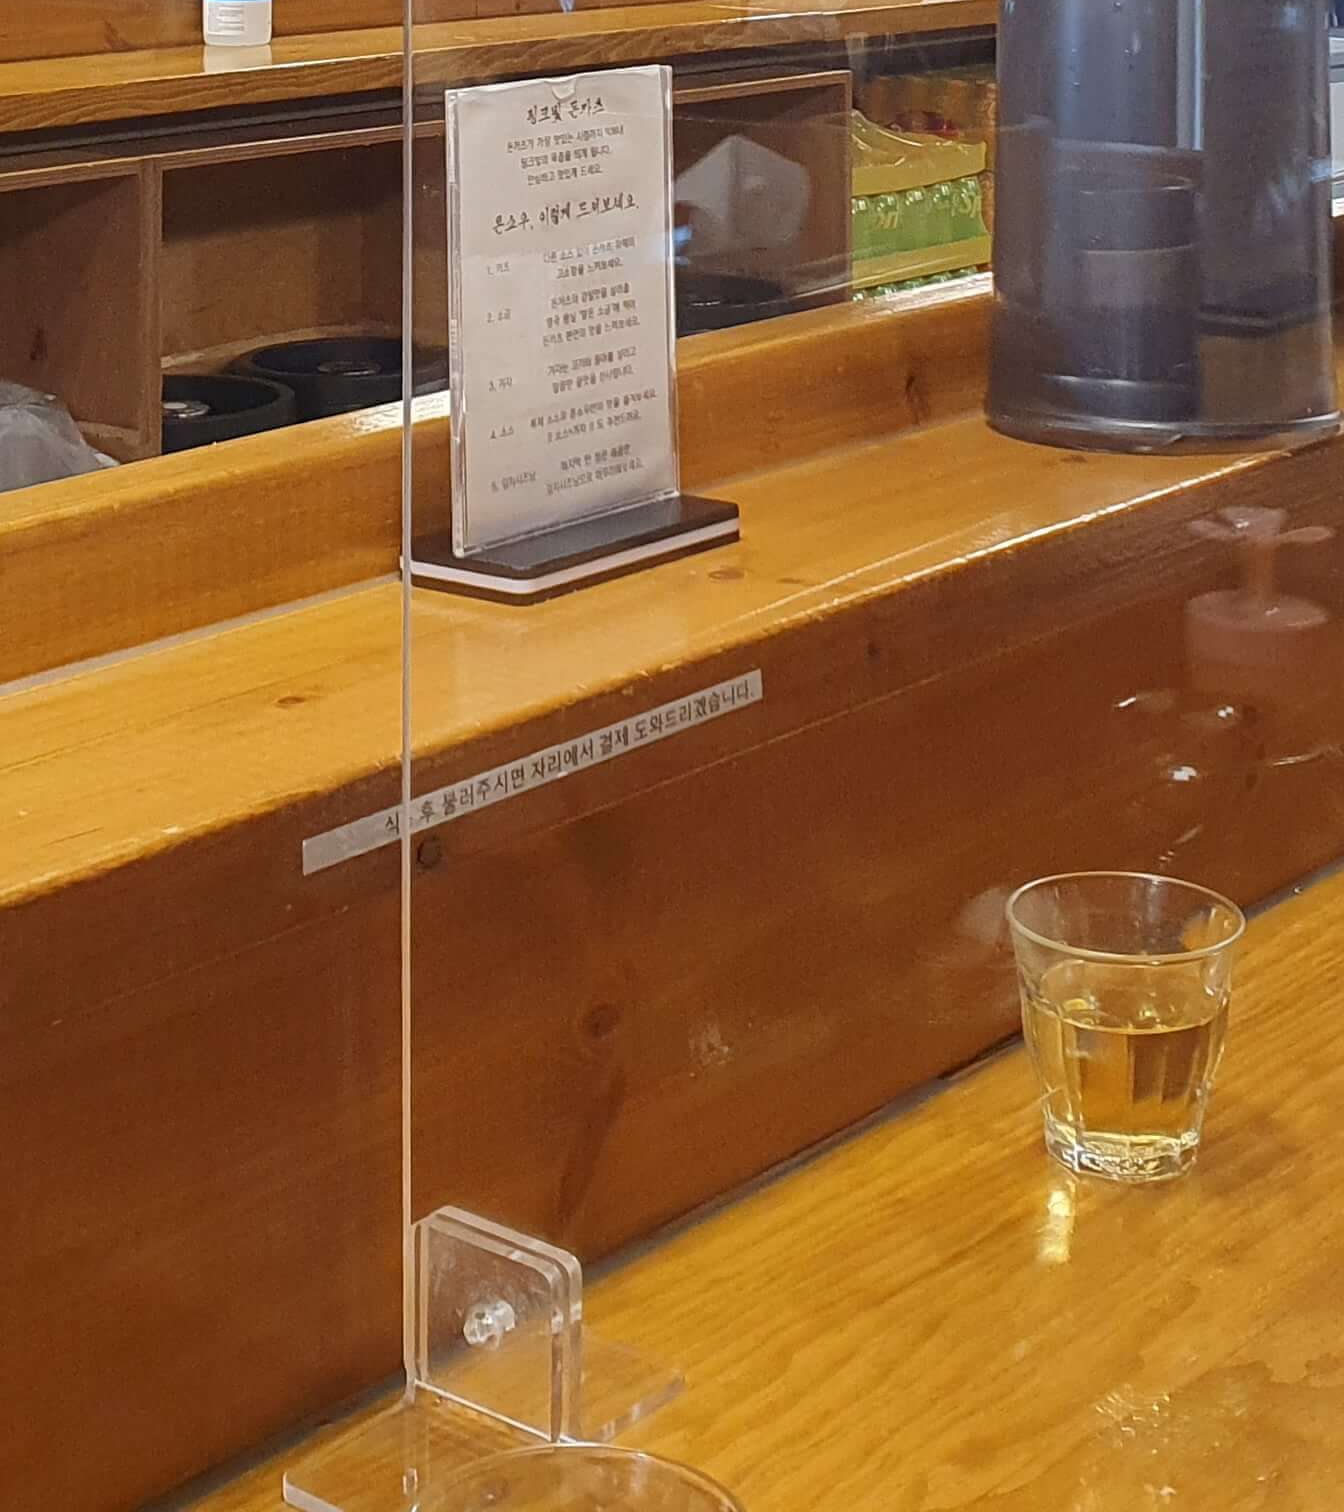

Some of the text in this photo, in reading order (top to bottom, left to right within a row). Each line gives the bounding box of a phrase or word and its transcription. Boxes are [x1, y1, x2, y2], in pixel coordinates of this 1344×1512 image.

[385, 679, 755, 834] 식 후 불러주시면 자리에서 결제 도와드리겠습니다.
